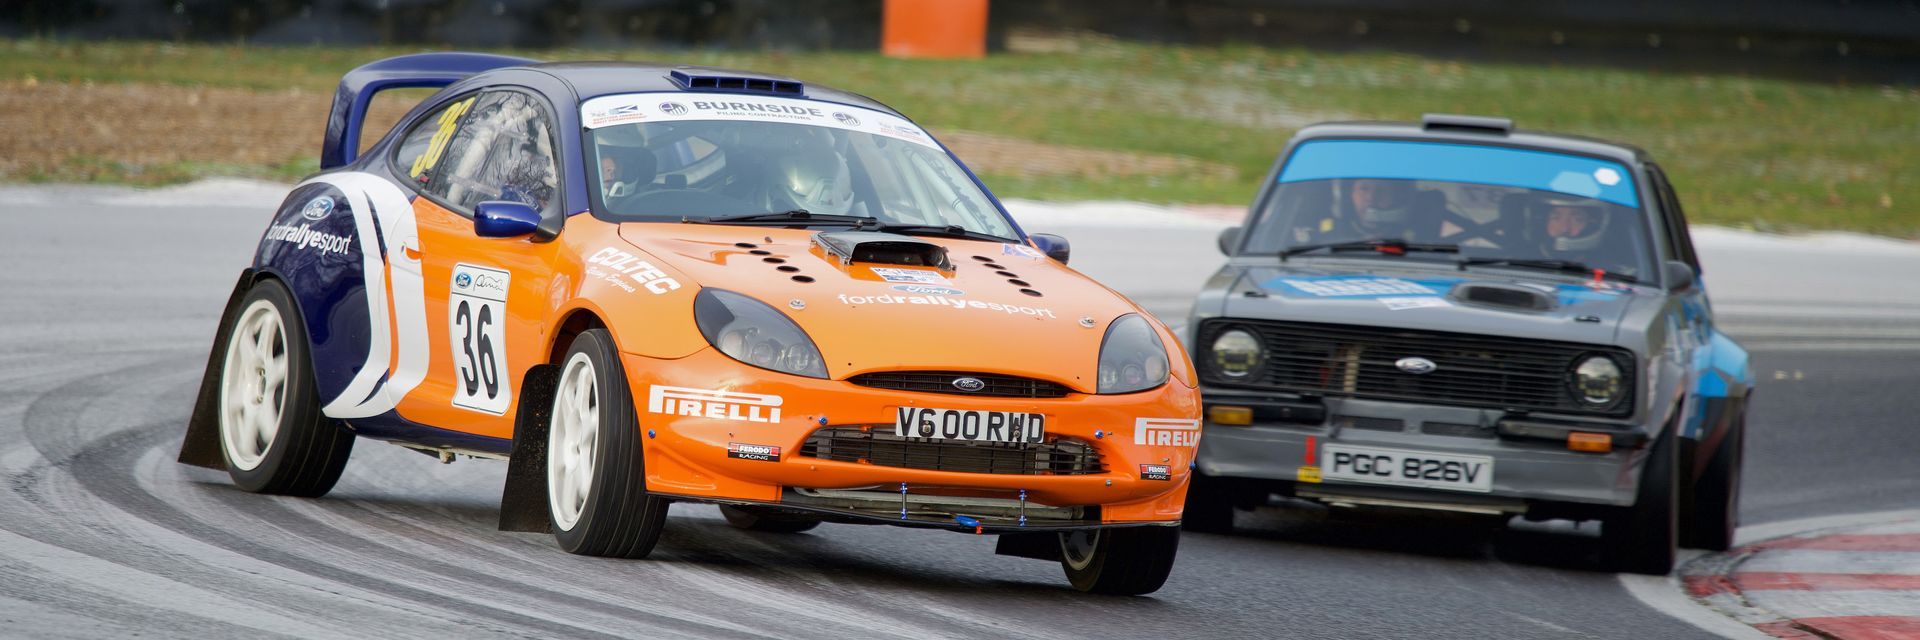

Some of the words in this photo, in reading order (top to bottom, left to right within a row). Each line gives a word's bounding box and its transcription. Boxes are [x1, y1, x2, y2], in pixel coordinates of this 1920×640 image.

[692, 101, 825, 117] BURNSIDE
[748, 112, 812, 121] CONTRACTORS
[411, 97, 475, 177] 36
[305, 198, 331, 218] Ford
[265, 221, 352, 256] fordrallyesport
[588, 247, 681, 294] COLTEC
[905, 285, 952, 295] Ford
[838, 293, 1057, 319] fordrallyesport
[456, 300, 499, 400] 36
[959, 379, 979, 389] Ford
[648, 384, 783, 424] PIRELLI
[738, 453, 769, 461] RACING
[739, 445, 769, 454] FERODO
[1333, 452, 1392, 477] PGC
[1403, 457, 1482, 483] 826V
